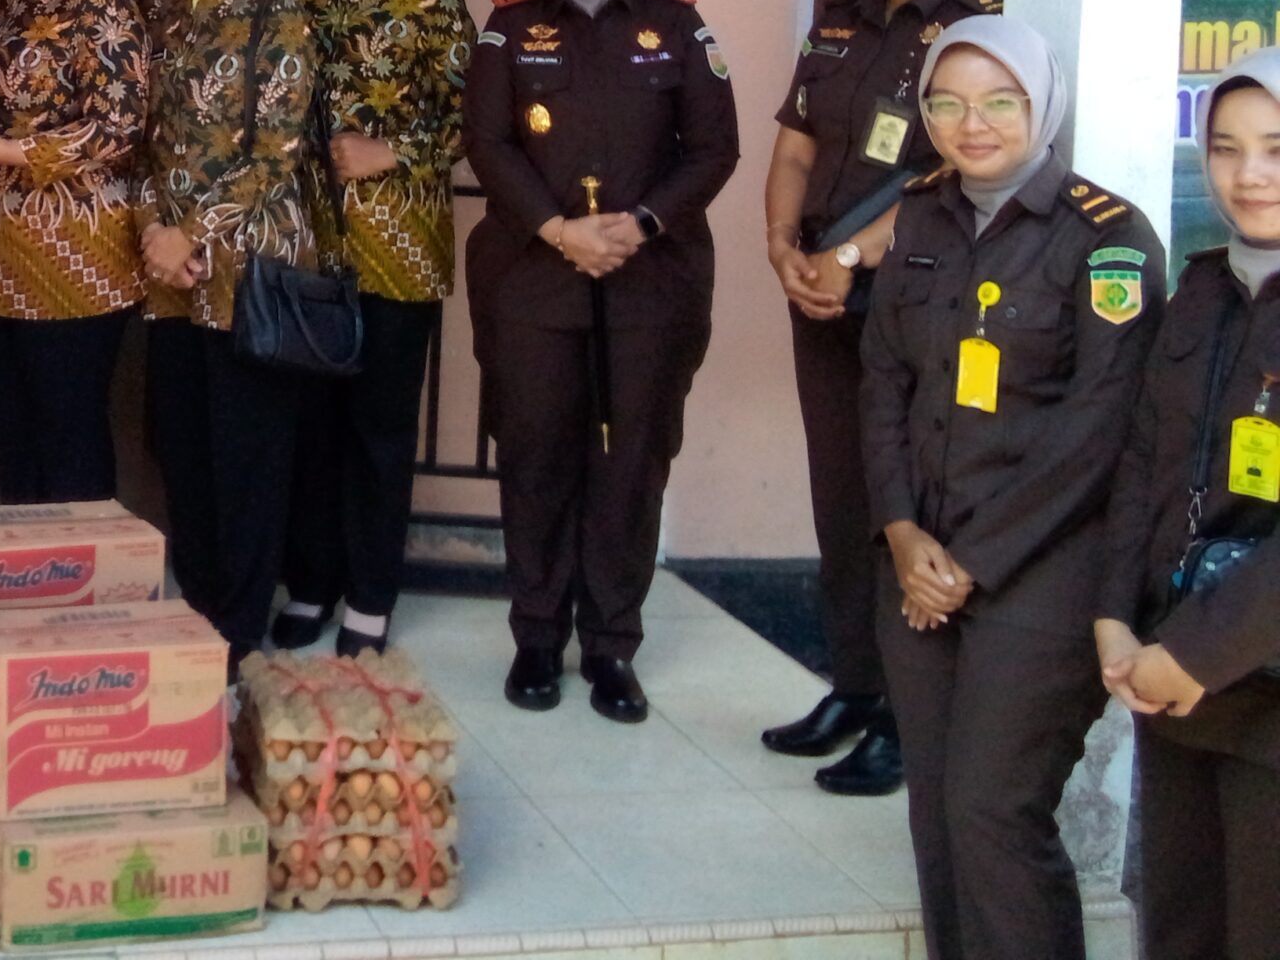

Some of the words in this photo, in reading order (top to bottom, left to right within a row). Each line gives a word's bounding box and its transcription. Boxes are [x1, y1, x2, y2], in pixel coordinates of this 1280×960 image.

[56, 746, 89, 772] Mi
[88, 747, 188, 776] goreng
[46, 874, 118, 910] SARI
[131, 868, 231, 900] MURNI
